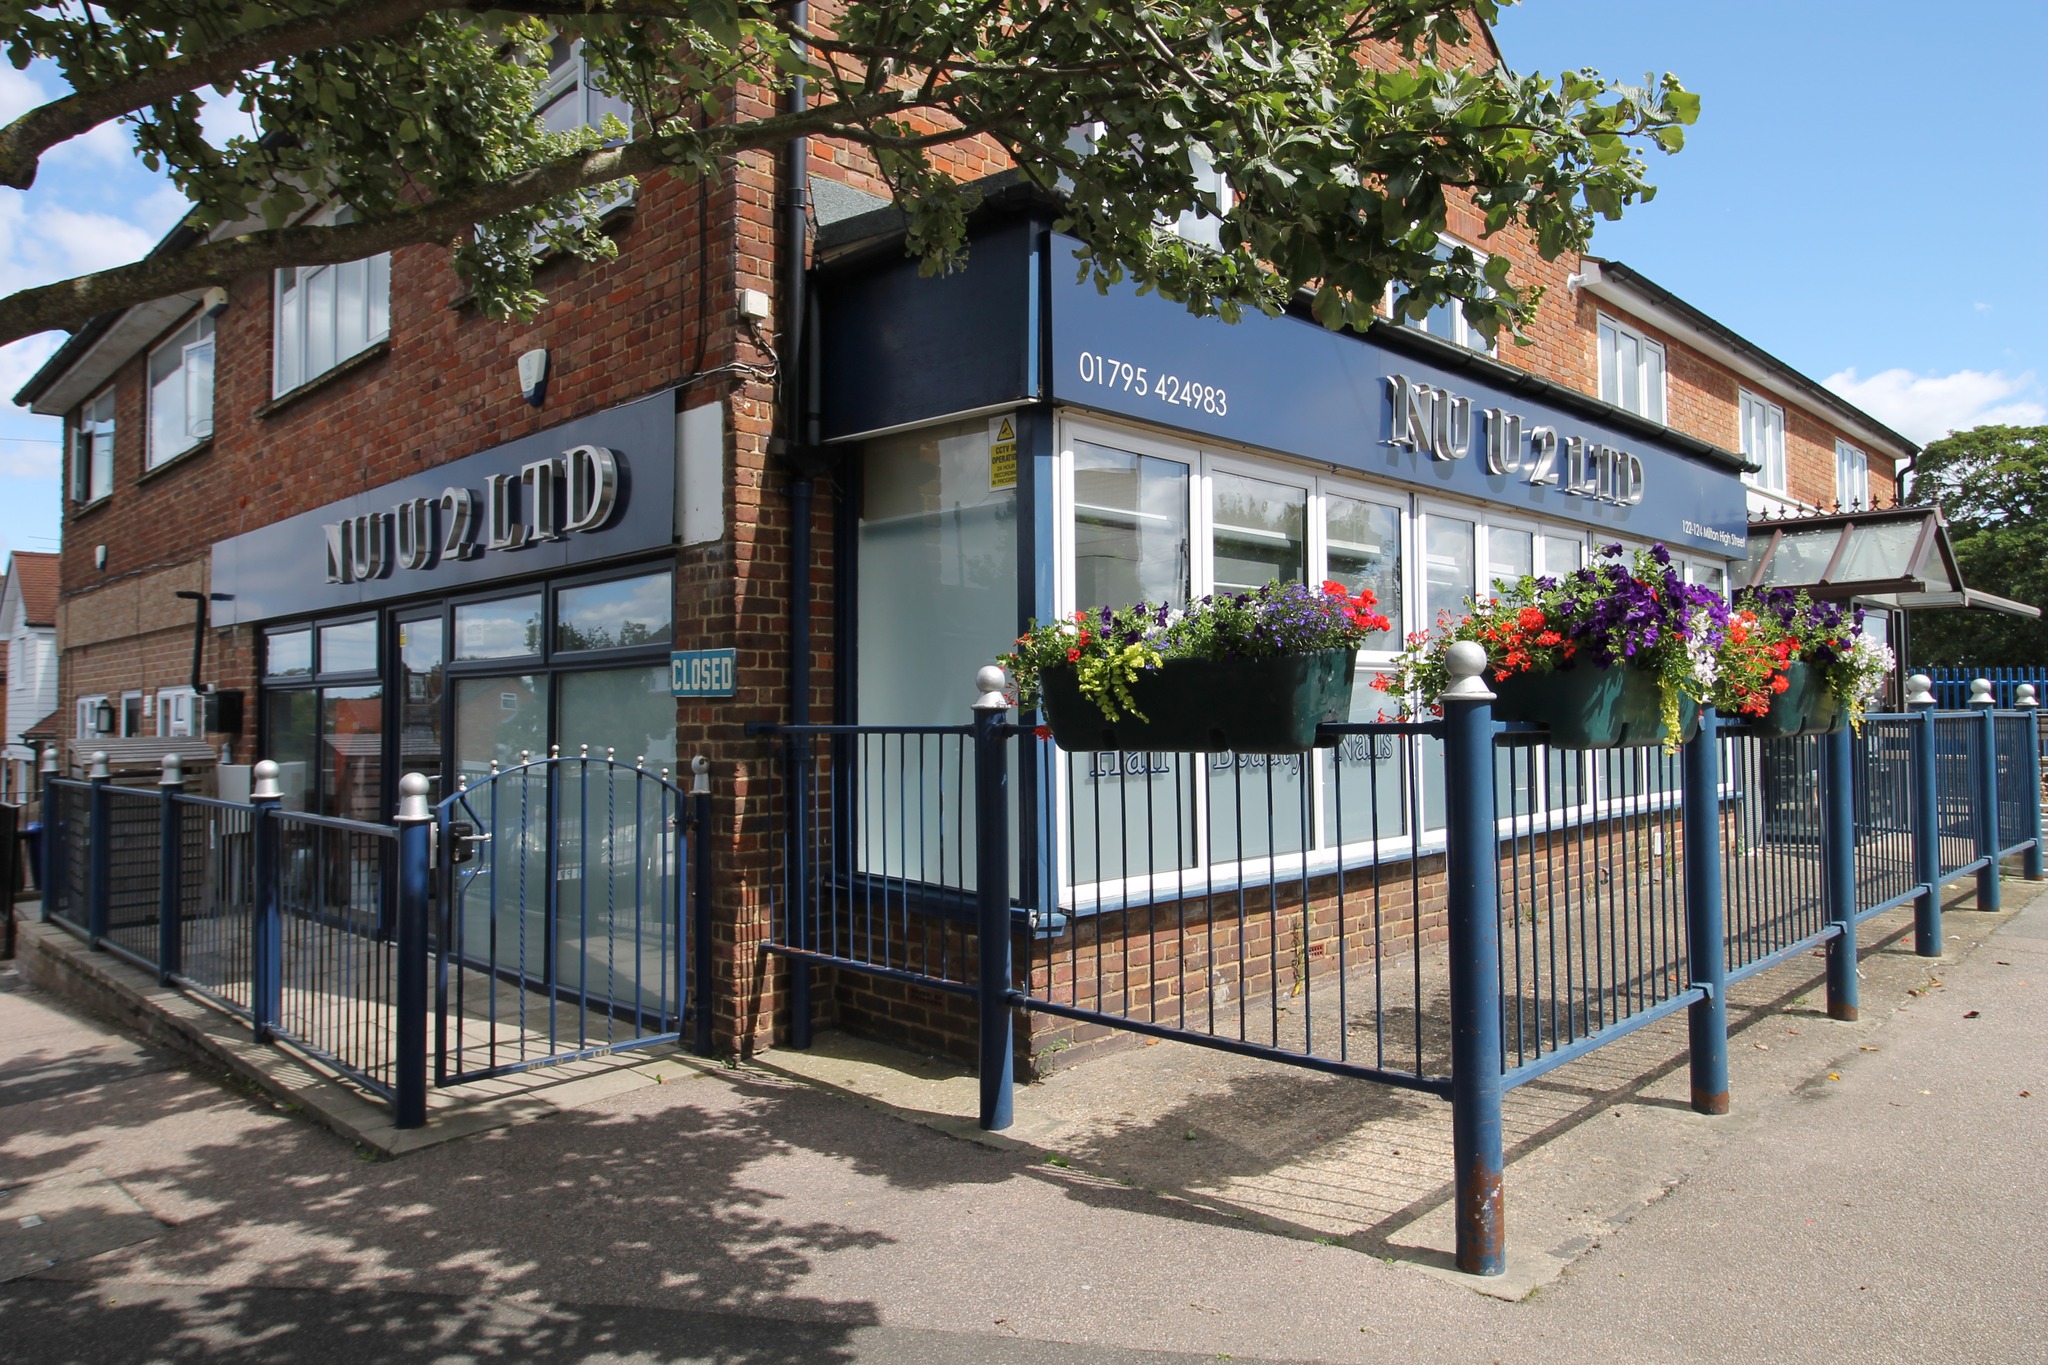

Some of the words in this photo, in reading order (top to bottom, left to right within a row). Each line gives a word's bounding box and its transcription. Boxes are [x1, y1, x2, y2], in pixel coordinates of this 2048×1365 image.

[1079, 352, 1148, 396] 01795
[1154, 373, 1227, 417] 424983
[996, 445, 1009, 454] CCTV
[1386, 374, 1474, 461] NU
[1565, 436, 1645, 507] LTD
[992, 453, 1017, 465] OPERATIO
[322, 511, 388, 584] NU
[484, 445, 618, 551] LTD
[1720, 530, 1731, 547] High
[1731, 533, 1746, 549] Street
[672, 657, 732, 690] CLOSED
[1333, 733, 1393, 761] Nals
